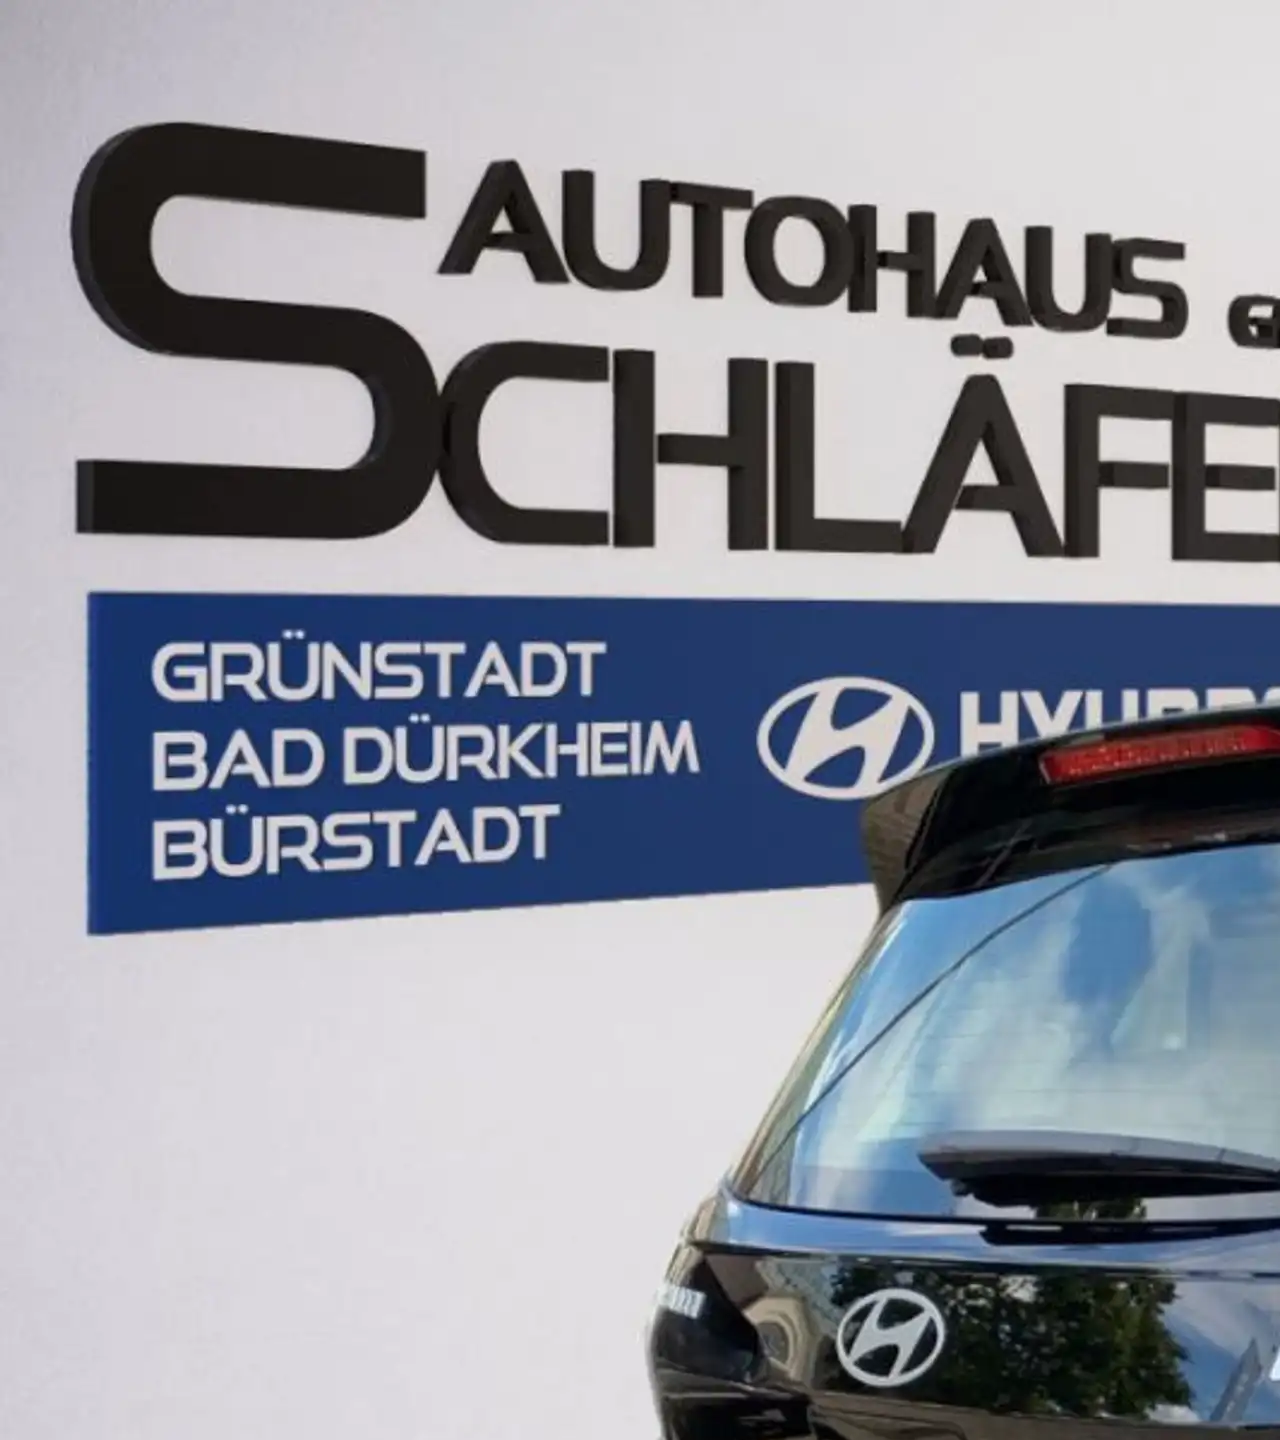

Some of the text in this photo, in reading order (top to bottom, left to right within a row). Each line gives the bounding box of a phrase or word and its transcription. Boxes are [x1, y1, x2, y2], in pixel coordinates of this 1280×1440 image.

[437, 158, 1189, 339] AUTOHAUS
[150, 628, 608, 702] GRÜNSTADT
[151, 713, 701, 791] BAD DÜRKHEIM
[151, 803, 562, 881] BÜRSTADT
